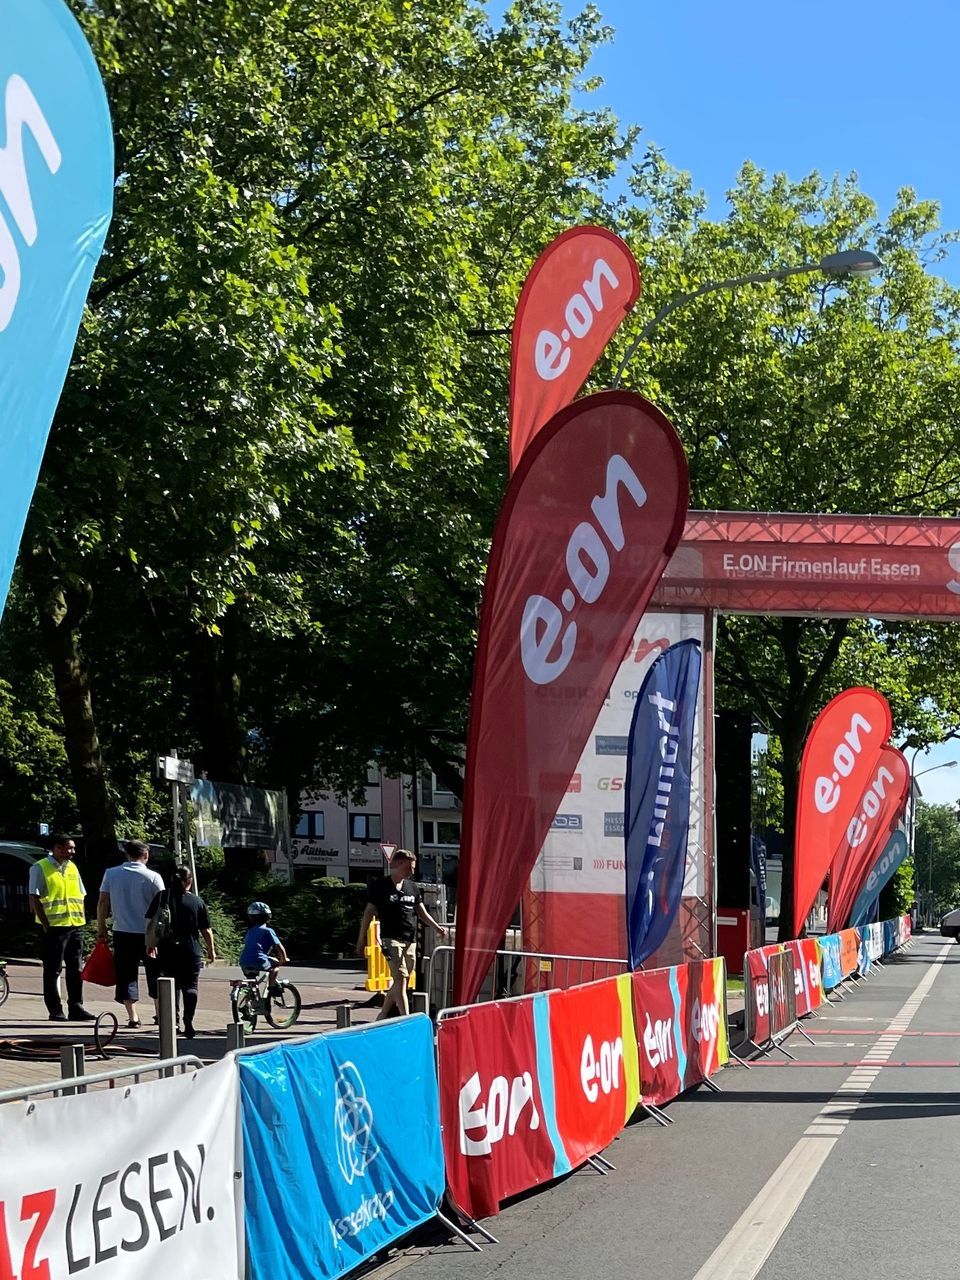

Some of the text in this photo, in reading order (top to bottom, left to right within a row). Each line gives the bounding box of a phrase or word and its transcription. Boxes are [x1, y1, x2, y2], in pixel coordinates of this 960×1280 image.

[723, 553, 921, 577] E.ON Firmenlauf Essen
[65, 1143, 215, 1275] LESEN.
